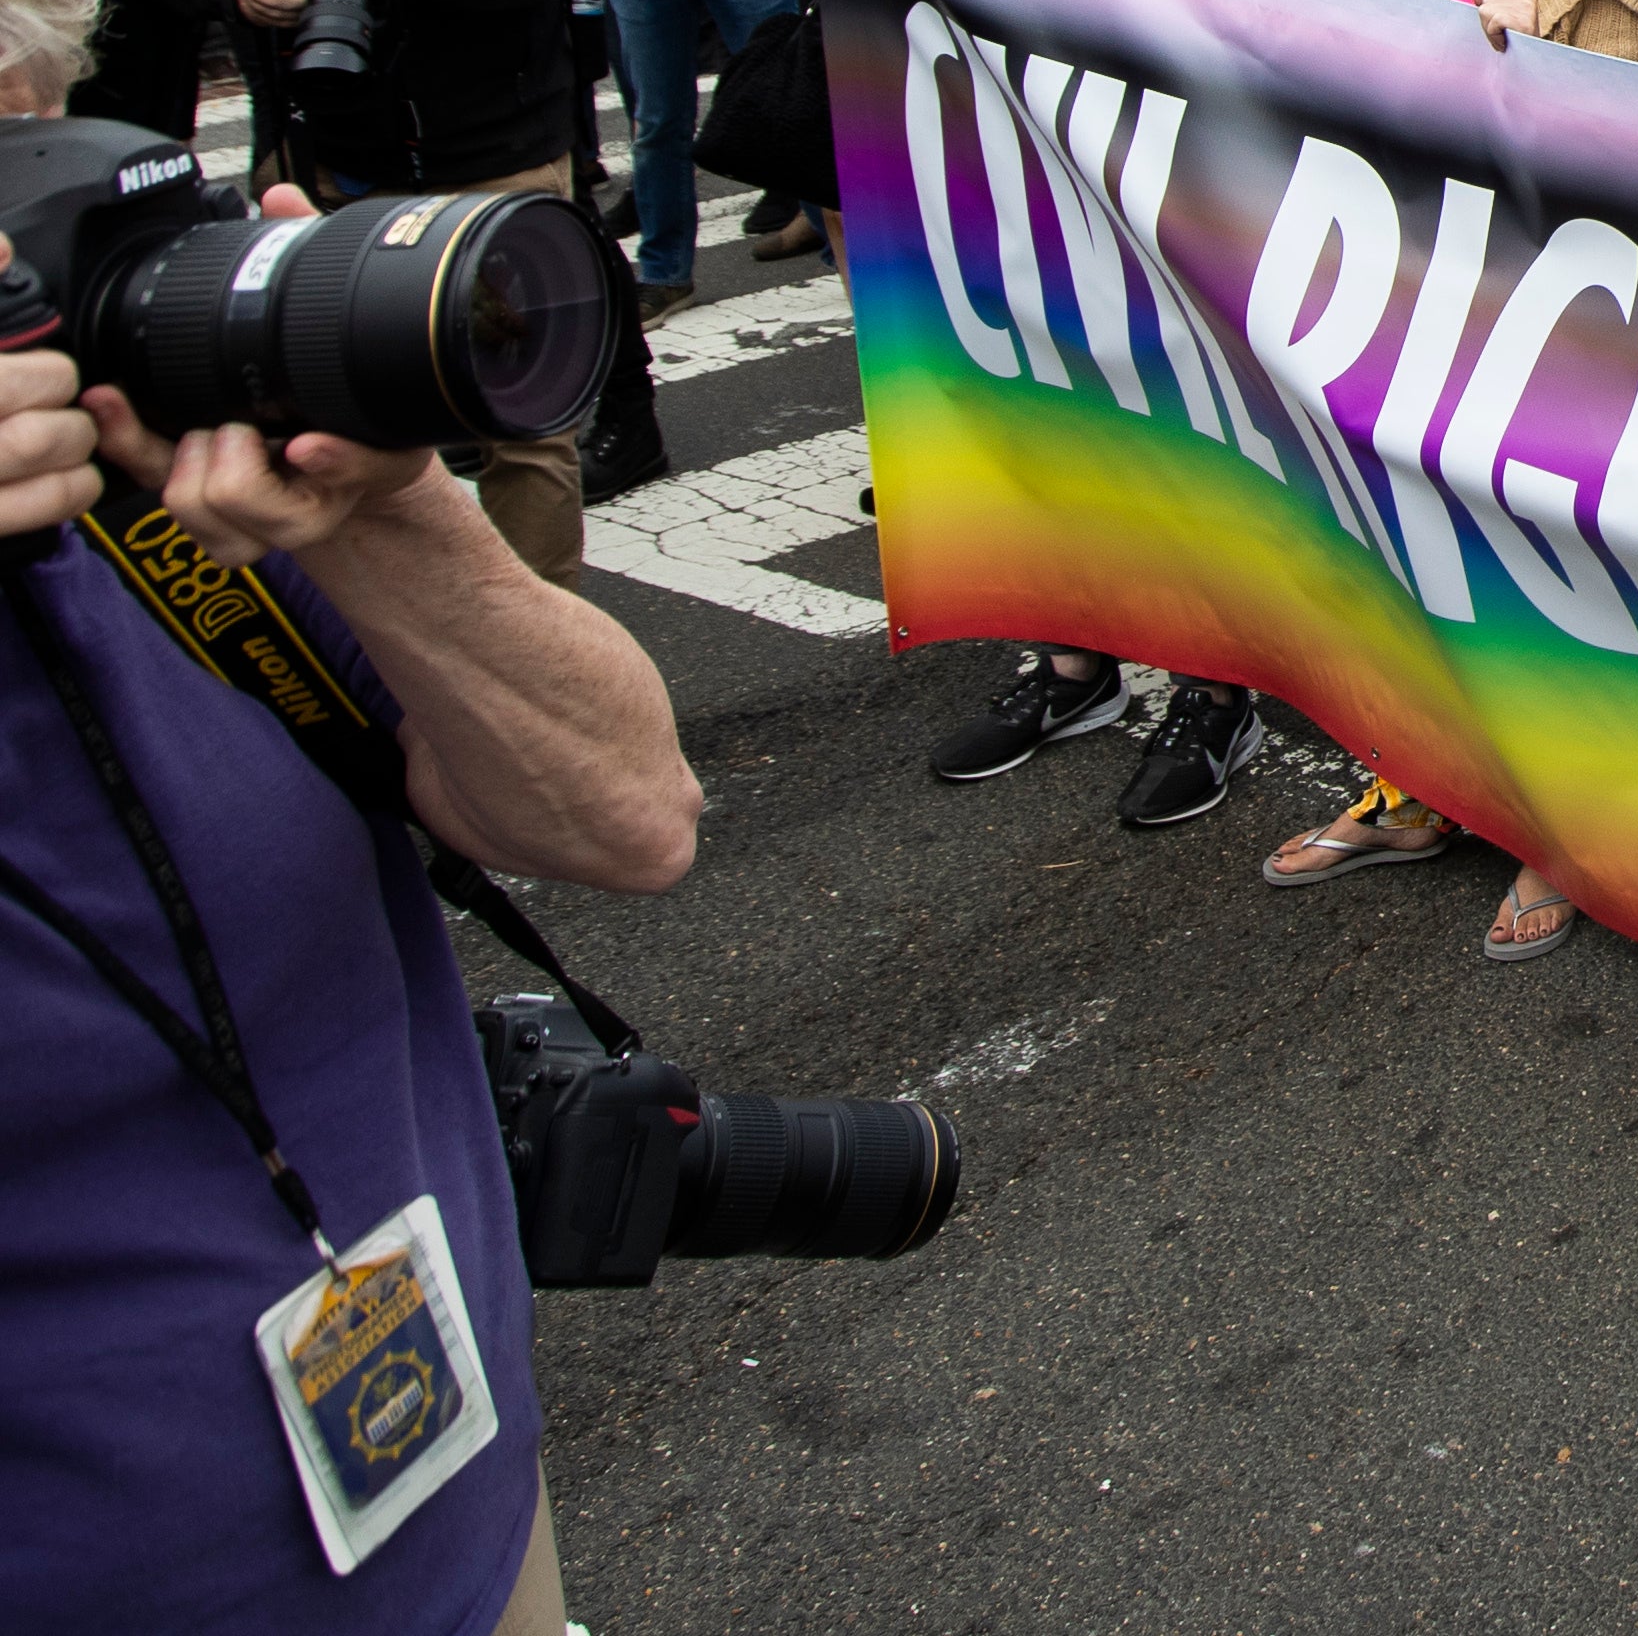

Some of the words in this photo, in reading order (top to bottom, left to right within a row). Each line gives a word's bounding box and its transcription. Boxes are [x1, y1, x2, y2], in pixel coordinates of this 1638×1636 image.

[119, 150, 193, 196] Nikon
[905, 1, 1288, 485] CIVIL
[124, 507, 260, 642] D850
[242, 635, 330, 726] Nikon
